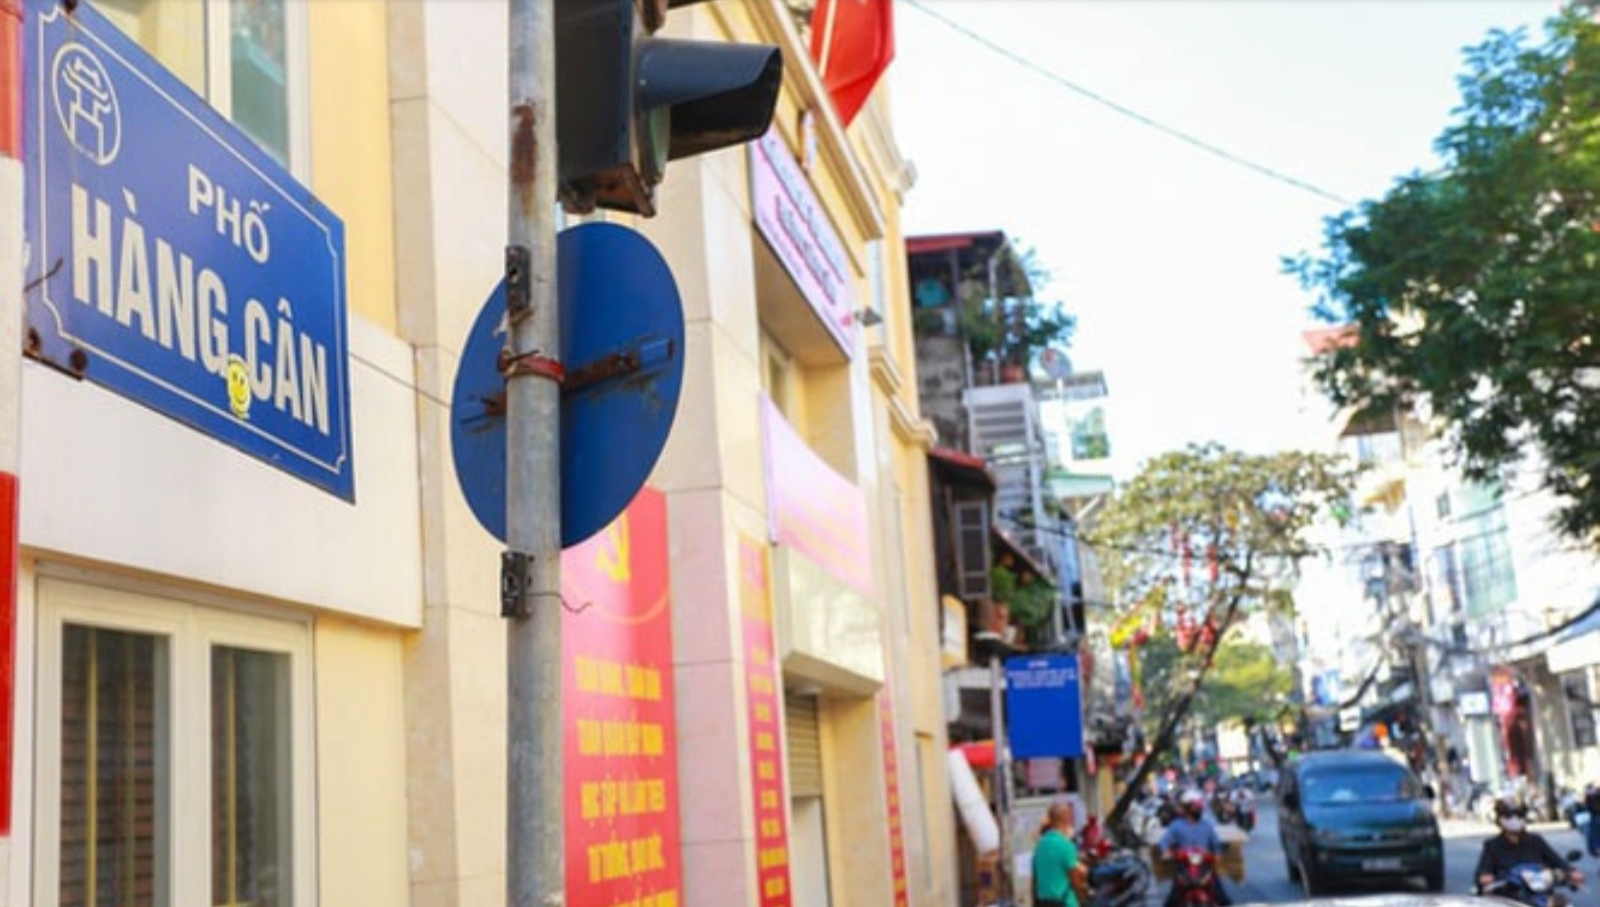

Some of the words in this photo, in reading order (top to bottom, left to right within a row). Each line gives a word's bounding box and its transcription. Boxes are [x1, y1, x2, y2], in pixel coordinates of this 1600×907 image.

[188, 163, 270, 264] PHỐ
[71, 183, 229, 379] HÀNG
[244, 298, 330, 435] CÂN
